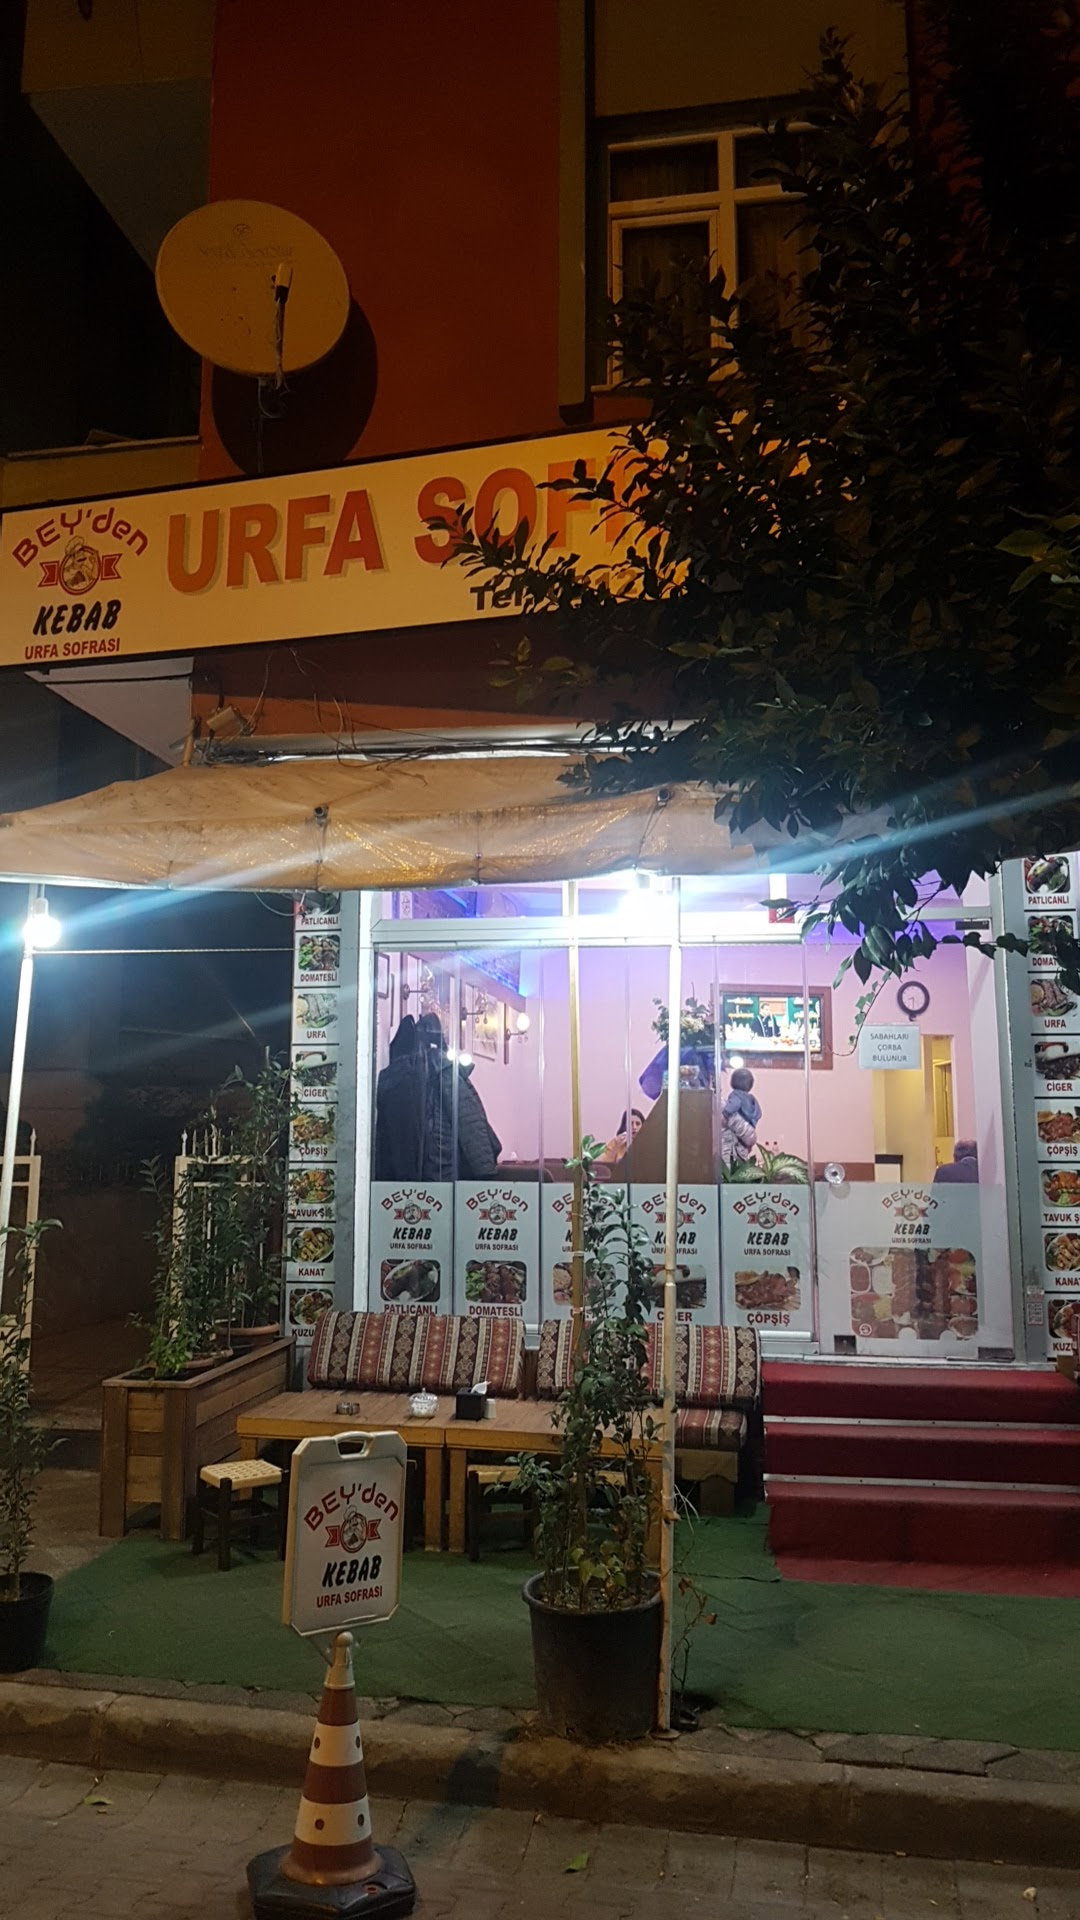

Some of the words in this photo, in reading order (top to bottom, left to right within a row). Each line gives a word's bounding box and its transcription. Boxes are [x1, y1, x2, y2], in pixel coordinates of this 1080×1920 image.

[167, 489, 386, 595] URFA
[33, 600, 121, 635] KEBAB
[25, 641, 59, 660] URFA
[62, 638, 120, 656] SOFRASI
[1044, 1019, 1066, 1028] URFA
[306, 1030, 326, 1039] URFA
[870, 1033, 909, 1041] SABAHLARI
[877, 1044, 902, 1052] ÇORBA
[291, 1208, 317, 1217] TAVUK
[1043, 1213, 1071, 1222] TAVUK
[393, 1227, 433, 1240] KEBAB
[478, 1227, 518, 1241] KEBAB
[894, 1223, 930, 1235] KEBAB
[747, 1231, 790, 1246] KEBAB
[475, 1242, 490, 1250] URFA
[744, 1247, 761, 1255] URFA
[298, 1268, 325, 1277] KANAT
[322, 1555, 382, 1587] KEBAB
[317, 1594, 342, 1608] URFA
[344, 1585, 382, 1603] SOFRASI
